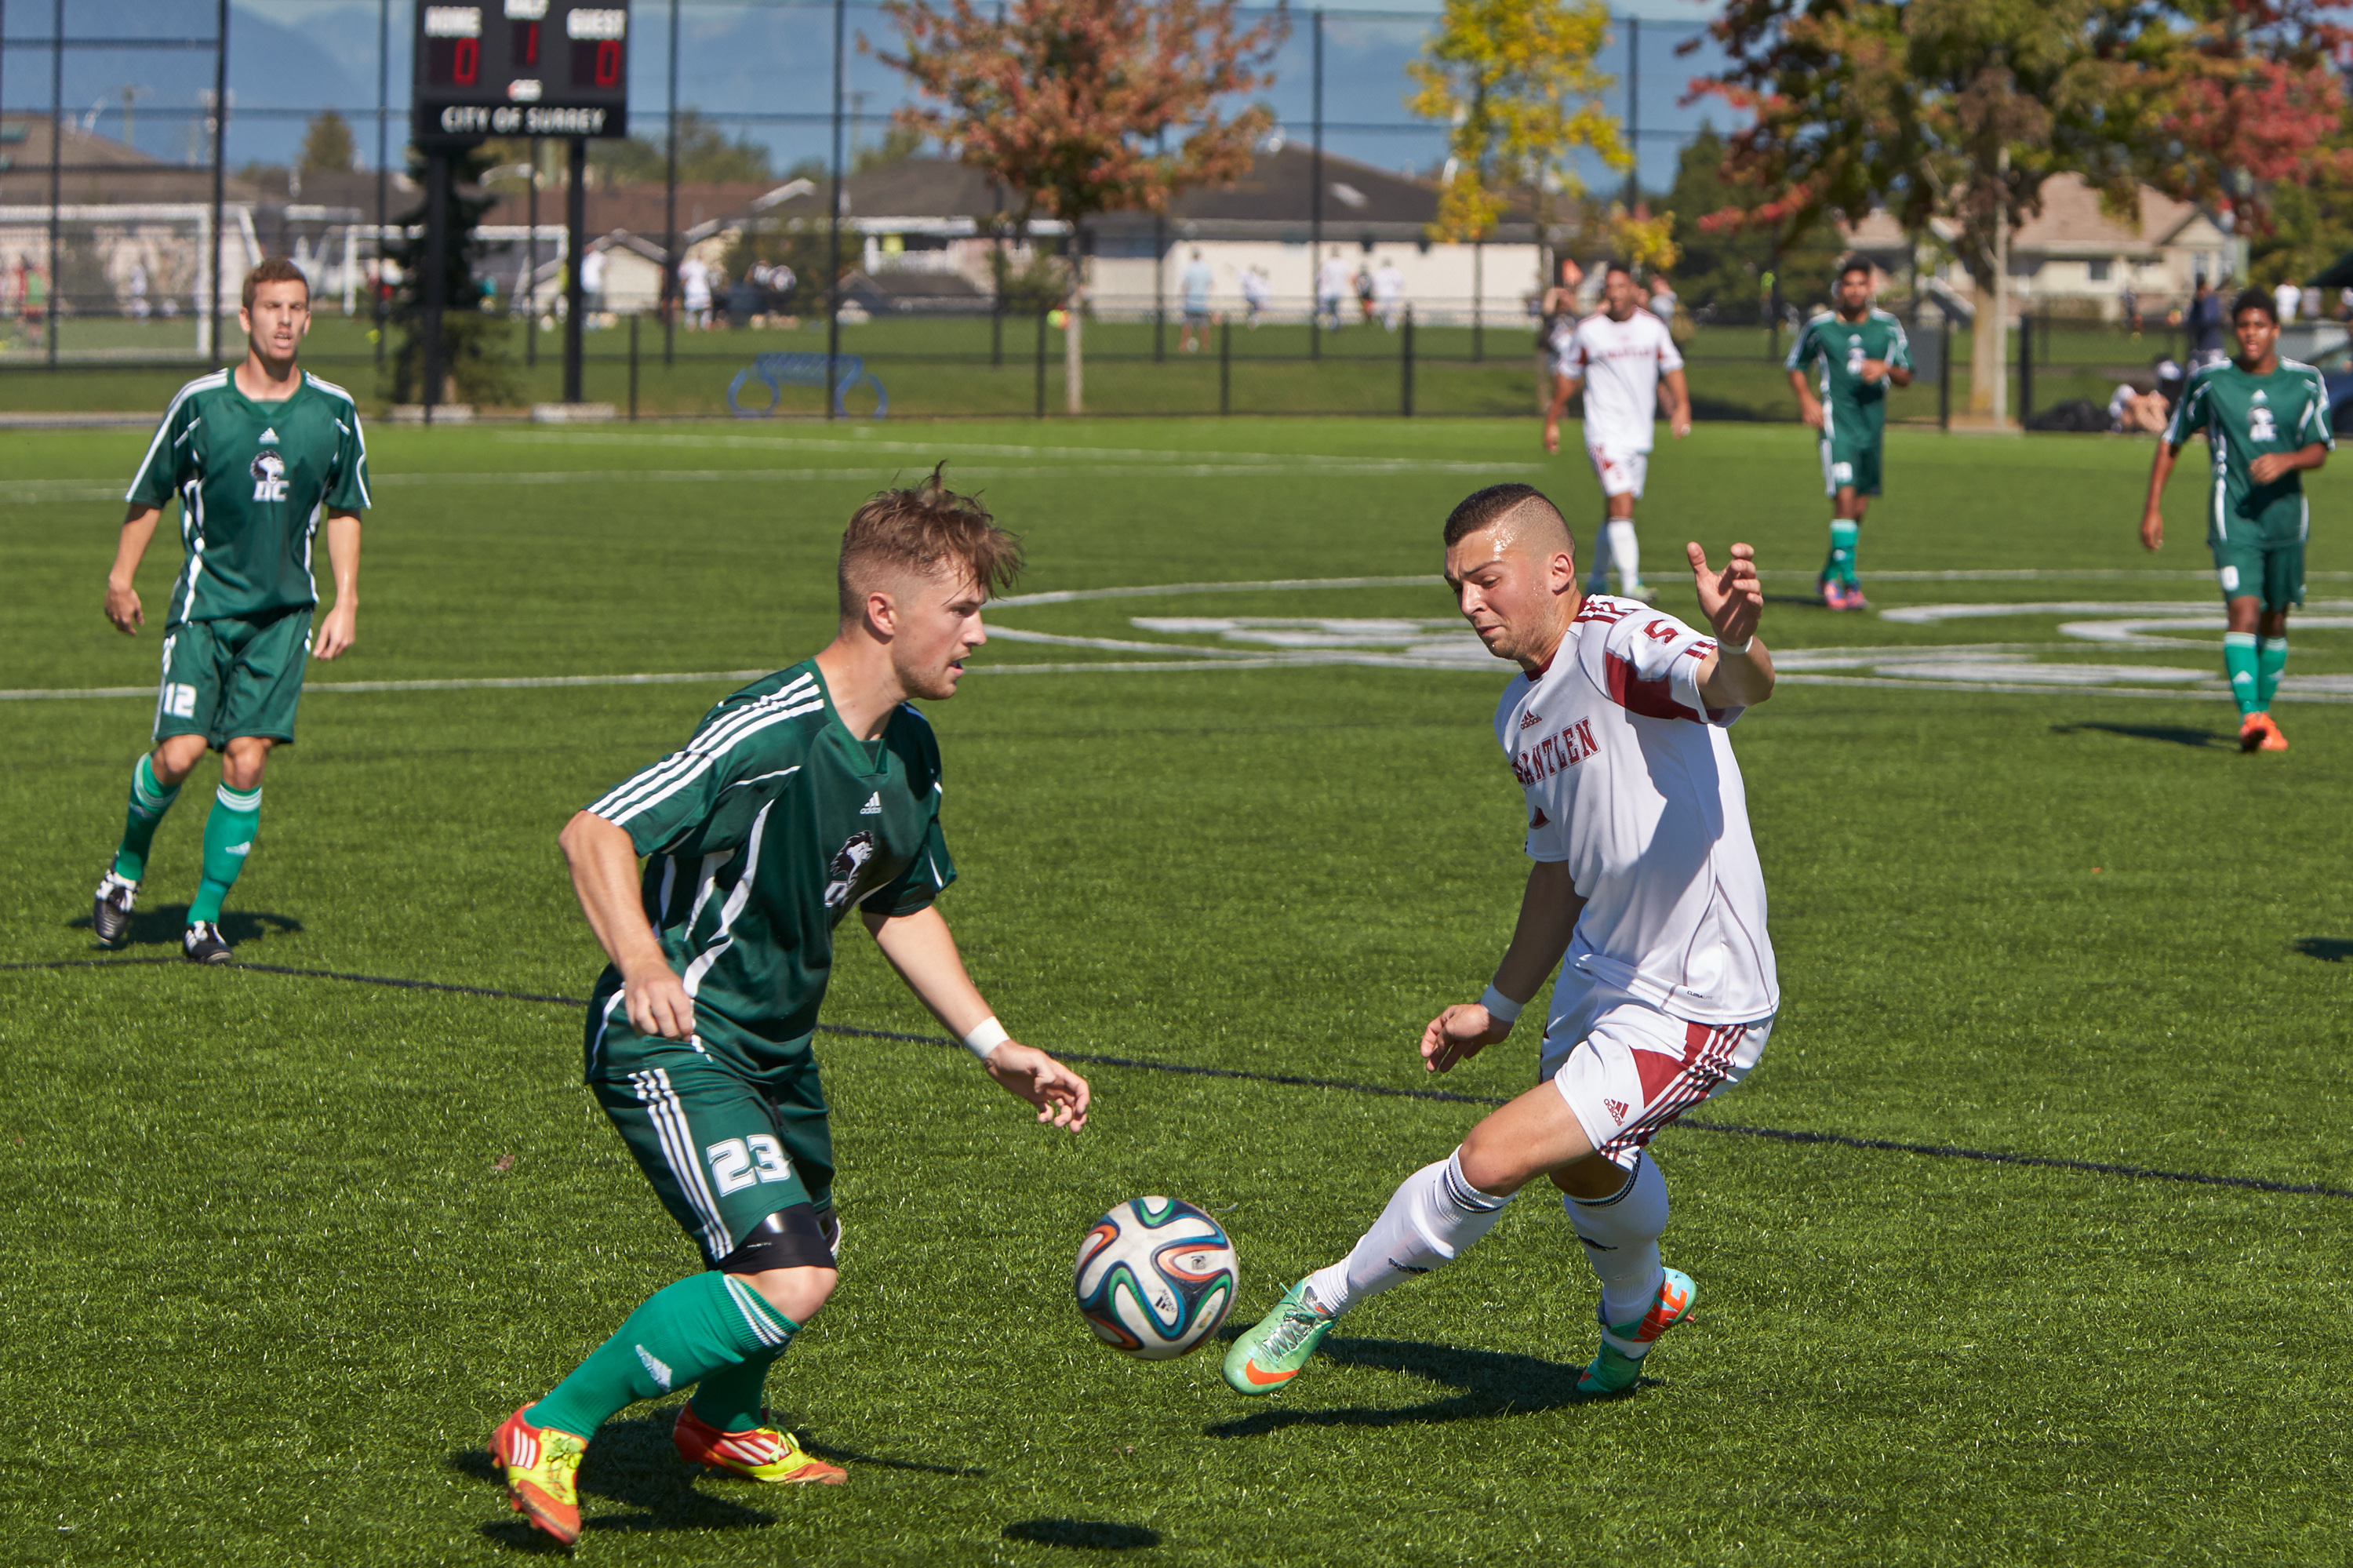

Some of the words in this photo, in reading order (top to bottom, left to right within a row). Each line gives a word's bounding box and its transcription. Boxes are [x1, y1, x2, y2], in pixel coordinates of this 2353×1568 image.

[425, 6, 482, 38] HOME
[567, 9, 626, 39] GUEST
[453, 38, 480, 86] 0
[595, 39, 622, 88] 0
[441, 106, 491, 133] CITY
[493, 107, 523, 133] OF
[526, 107, 606, 133] SURREY
[1641, 618, 1681, 645] 5
[163, 682, 197, 719] 12
[860, 806, 882, 815] adidas
[1604, 1098, 1624, 1126] adidas
[706, 1133, 791, 1197] 23
